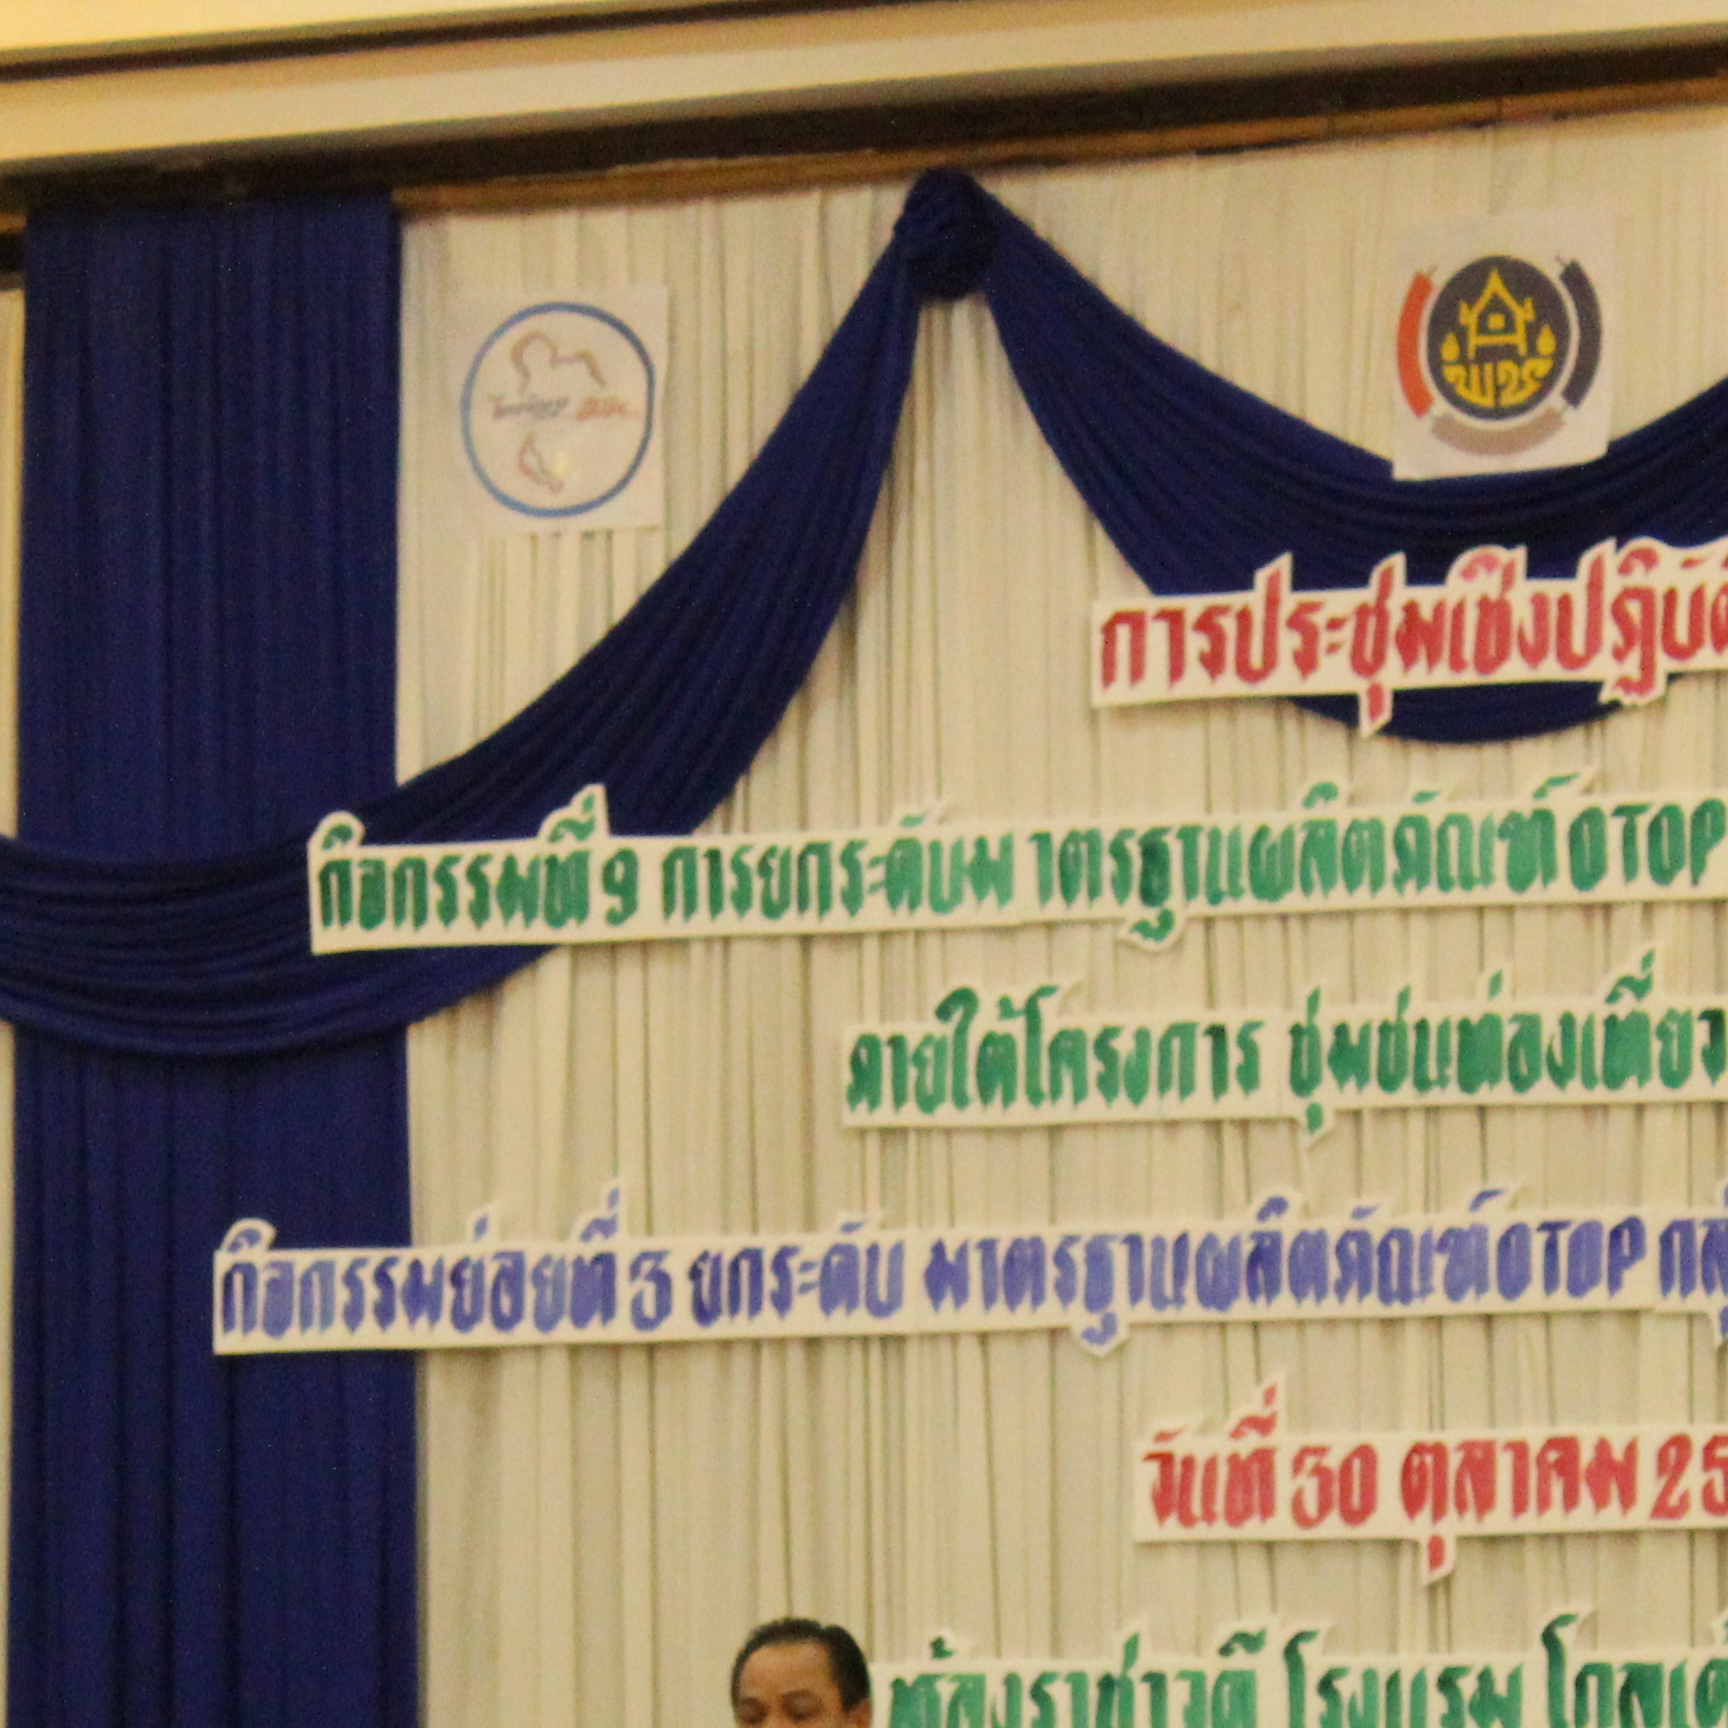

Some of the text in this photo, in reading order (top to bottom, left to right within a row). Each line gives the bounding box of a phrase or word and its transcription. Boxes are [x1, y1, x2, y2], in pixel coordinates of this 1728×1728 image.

[1143, 1383, 1278, 1530] วันที่
[1290, 1443, 1379, 1531] 30
[1398, 1435, 1639, 1573] ตุลาคม
